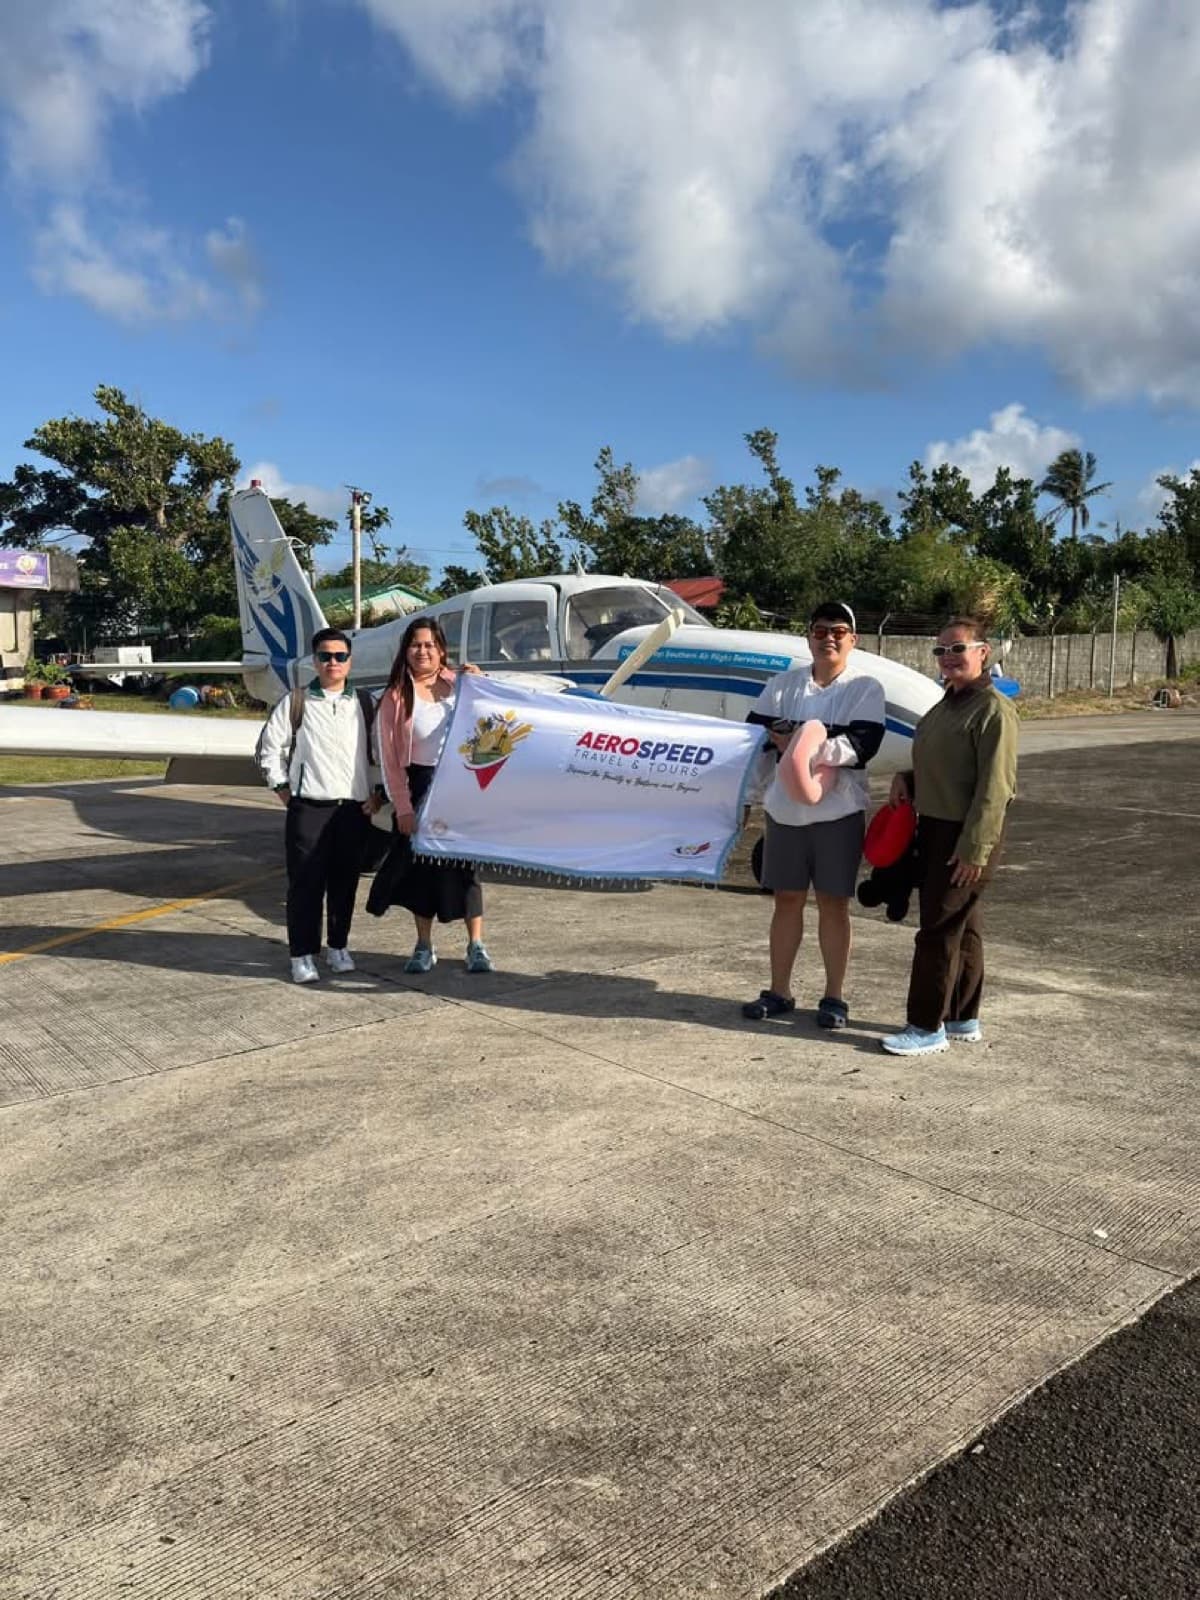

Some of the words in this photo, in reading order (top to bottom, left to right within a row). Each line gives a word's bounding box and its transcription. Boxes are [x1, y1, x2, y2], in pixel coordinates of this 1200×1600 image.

[574, 749, 622, 767] TRAVEL
[631, 760, 640, 770] &
[648, 762, 699, 777] TOURS
[576, 731, 714, 765] AEROSPEED
